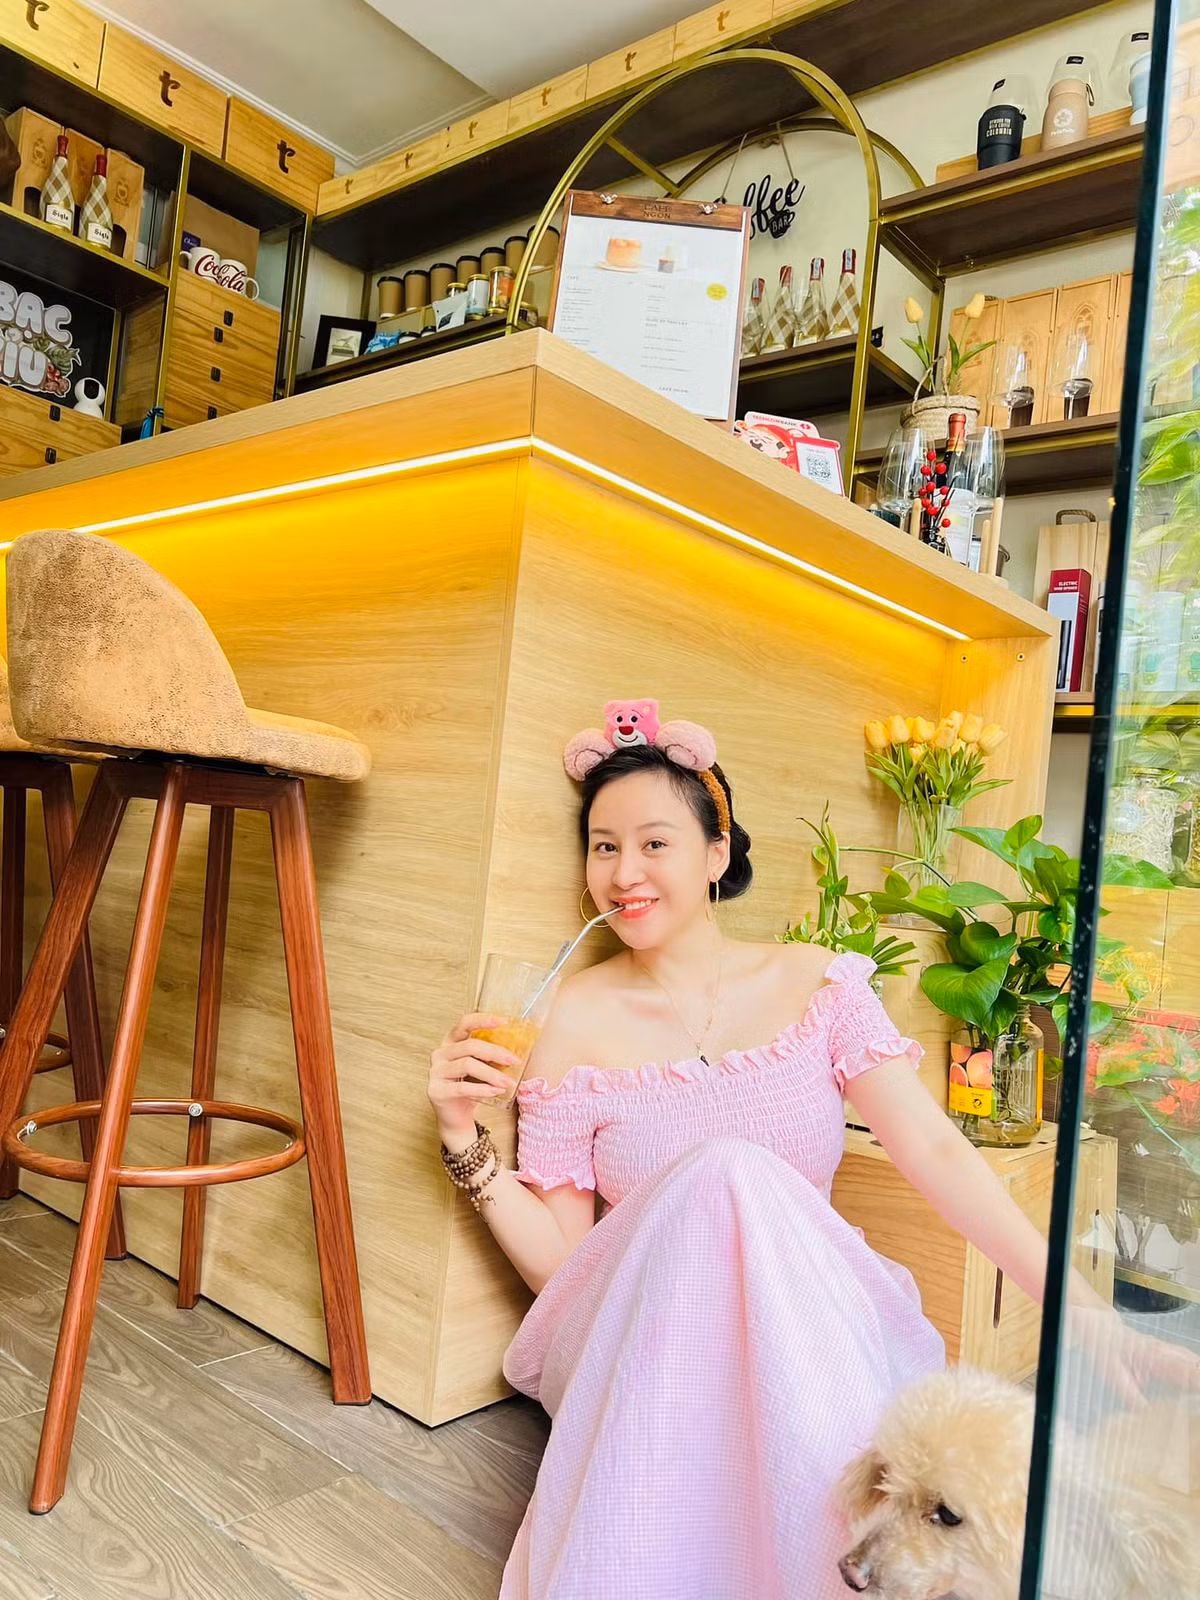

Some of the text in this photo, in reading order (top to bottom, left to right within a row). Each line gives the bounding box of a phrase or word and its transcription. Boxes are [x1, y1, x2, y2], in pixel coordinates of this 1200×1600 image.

[159, 70, 181, 107] t
[277, 139, 296, 174] t
[643, 211, 670, 219] NGON
[743, 174, 806, 240] ffee
[772, 216, 789, 232] BAR
